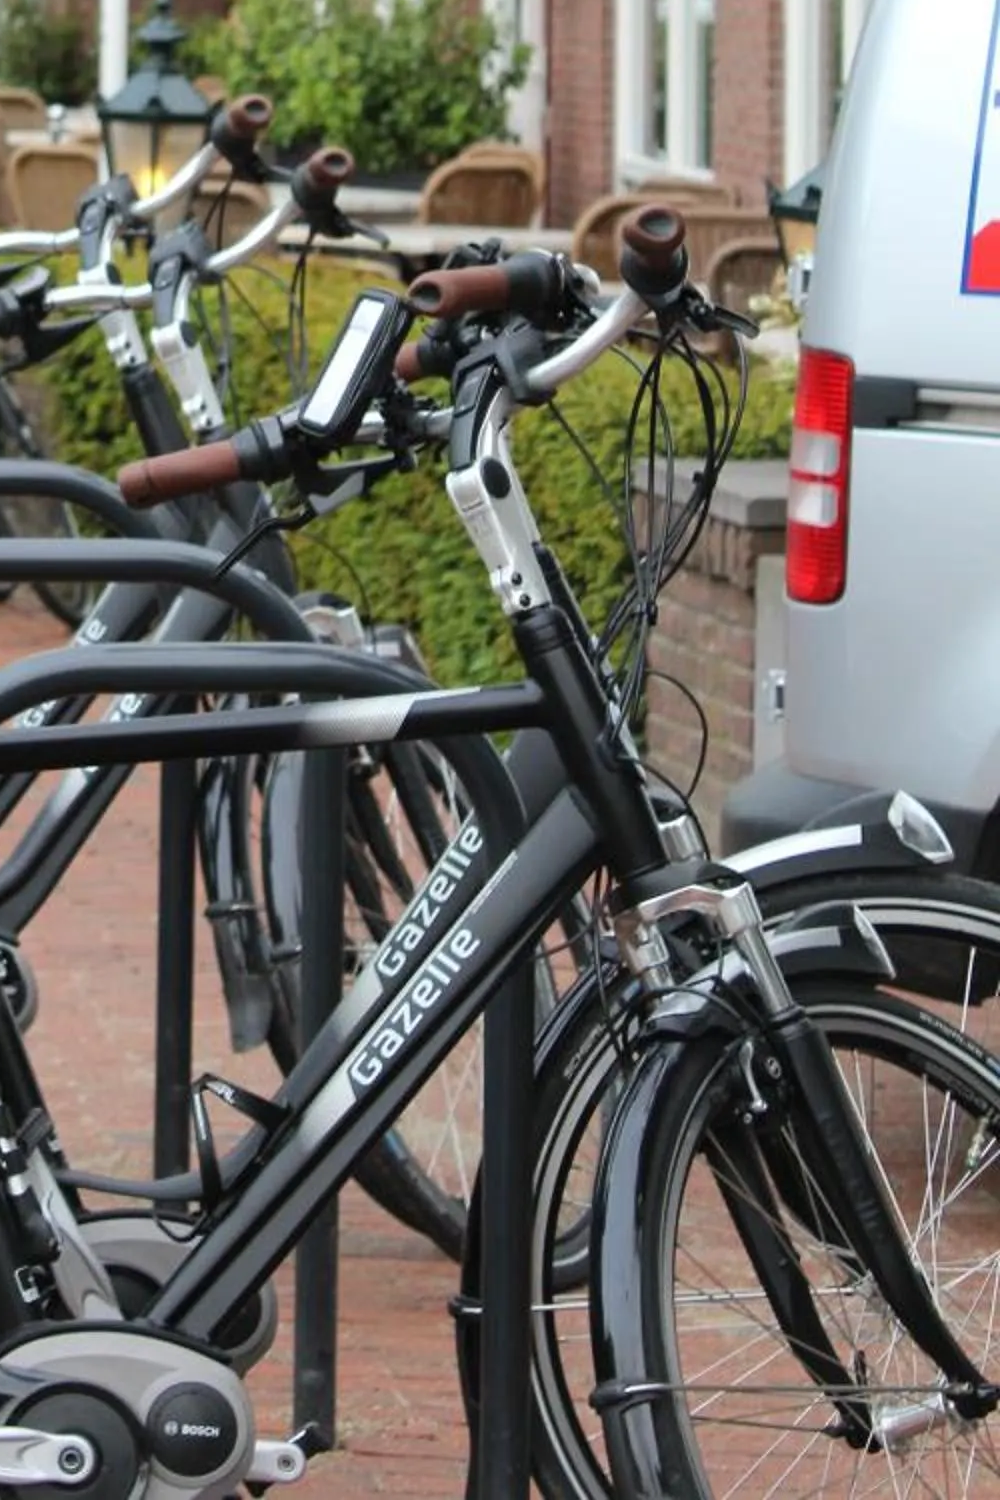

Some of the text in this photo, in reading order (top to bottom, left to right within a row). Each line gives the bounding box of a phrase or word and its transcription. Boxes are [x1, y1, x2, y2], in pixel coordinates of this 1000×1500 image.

[377, 824, 484, 977] Gazelle
[350, 928, 481, 1087] Gazelle
[182, 1423, 221, 1438] BOSCH
